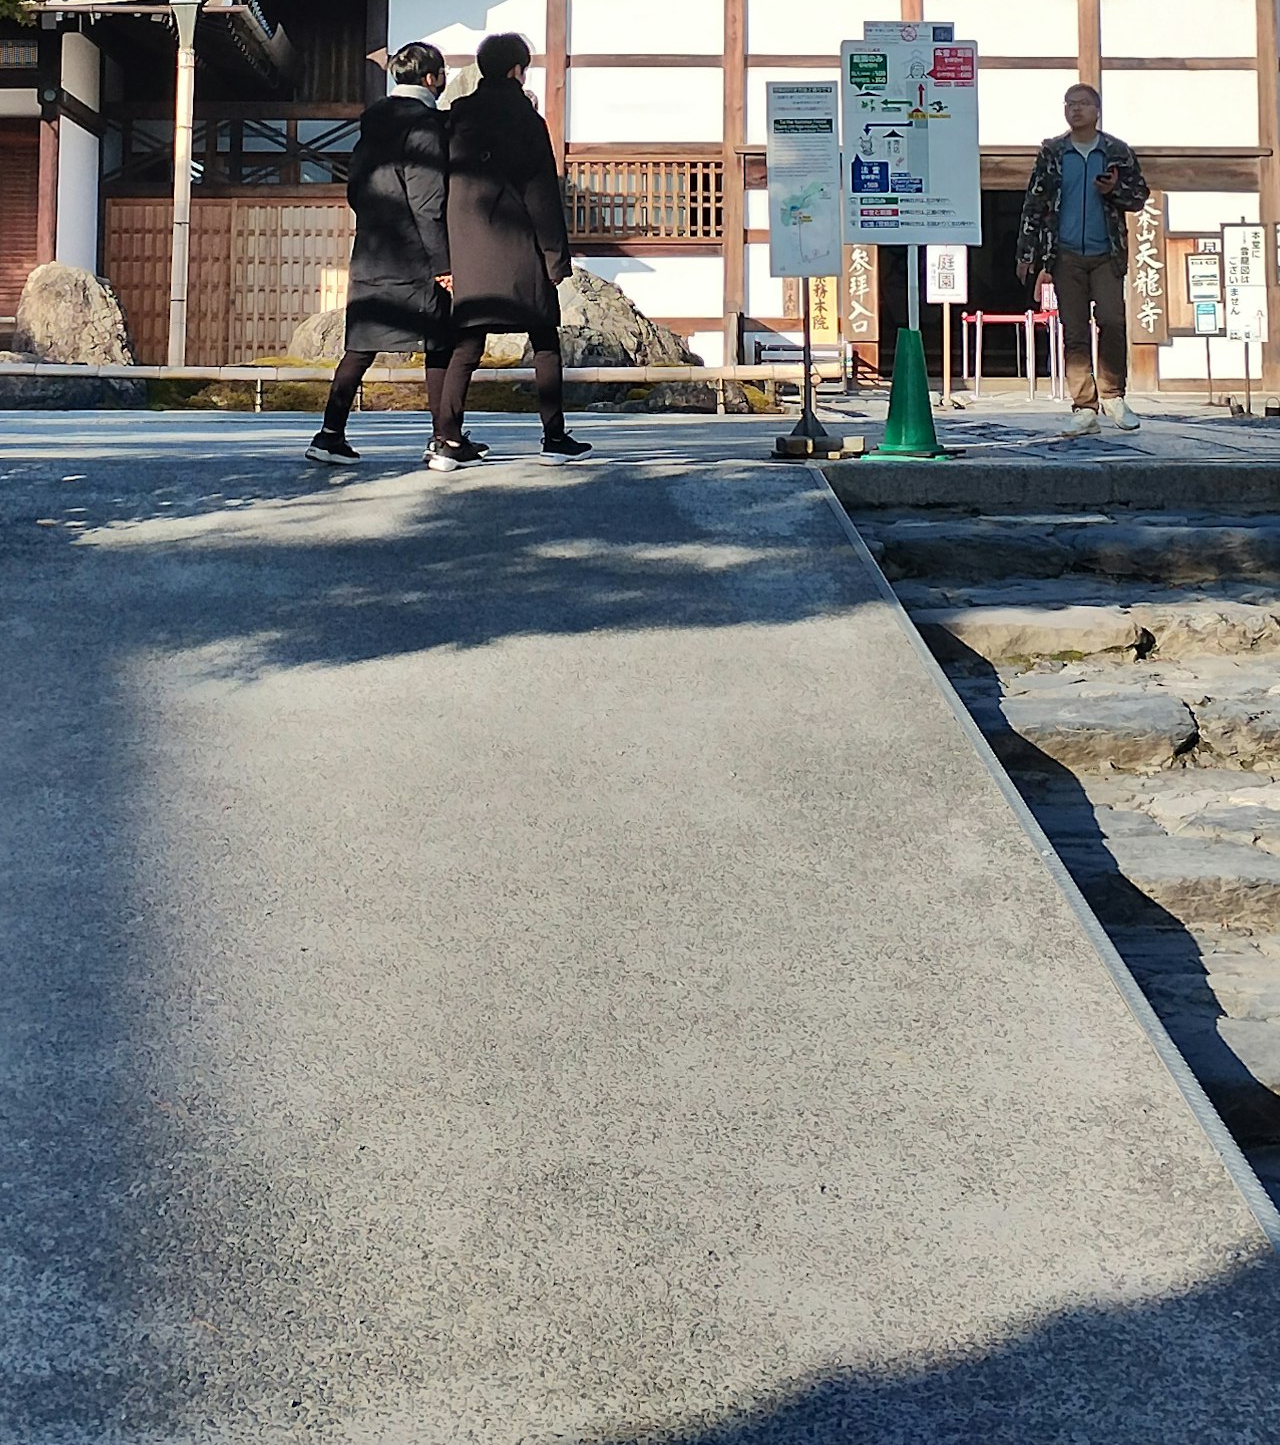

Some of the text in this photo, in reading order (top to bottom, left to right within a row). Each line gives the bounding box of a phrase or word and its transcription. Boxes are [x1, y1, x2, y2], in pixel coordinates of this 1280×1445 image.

[848, 244, 875, 333] 参拝入口
[937, 254, 955, 289] 庭園
[1228, 256, 1240, 315] ございません
